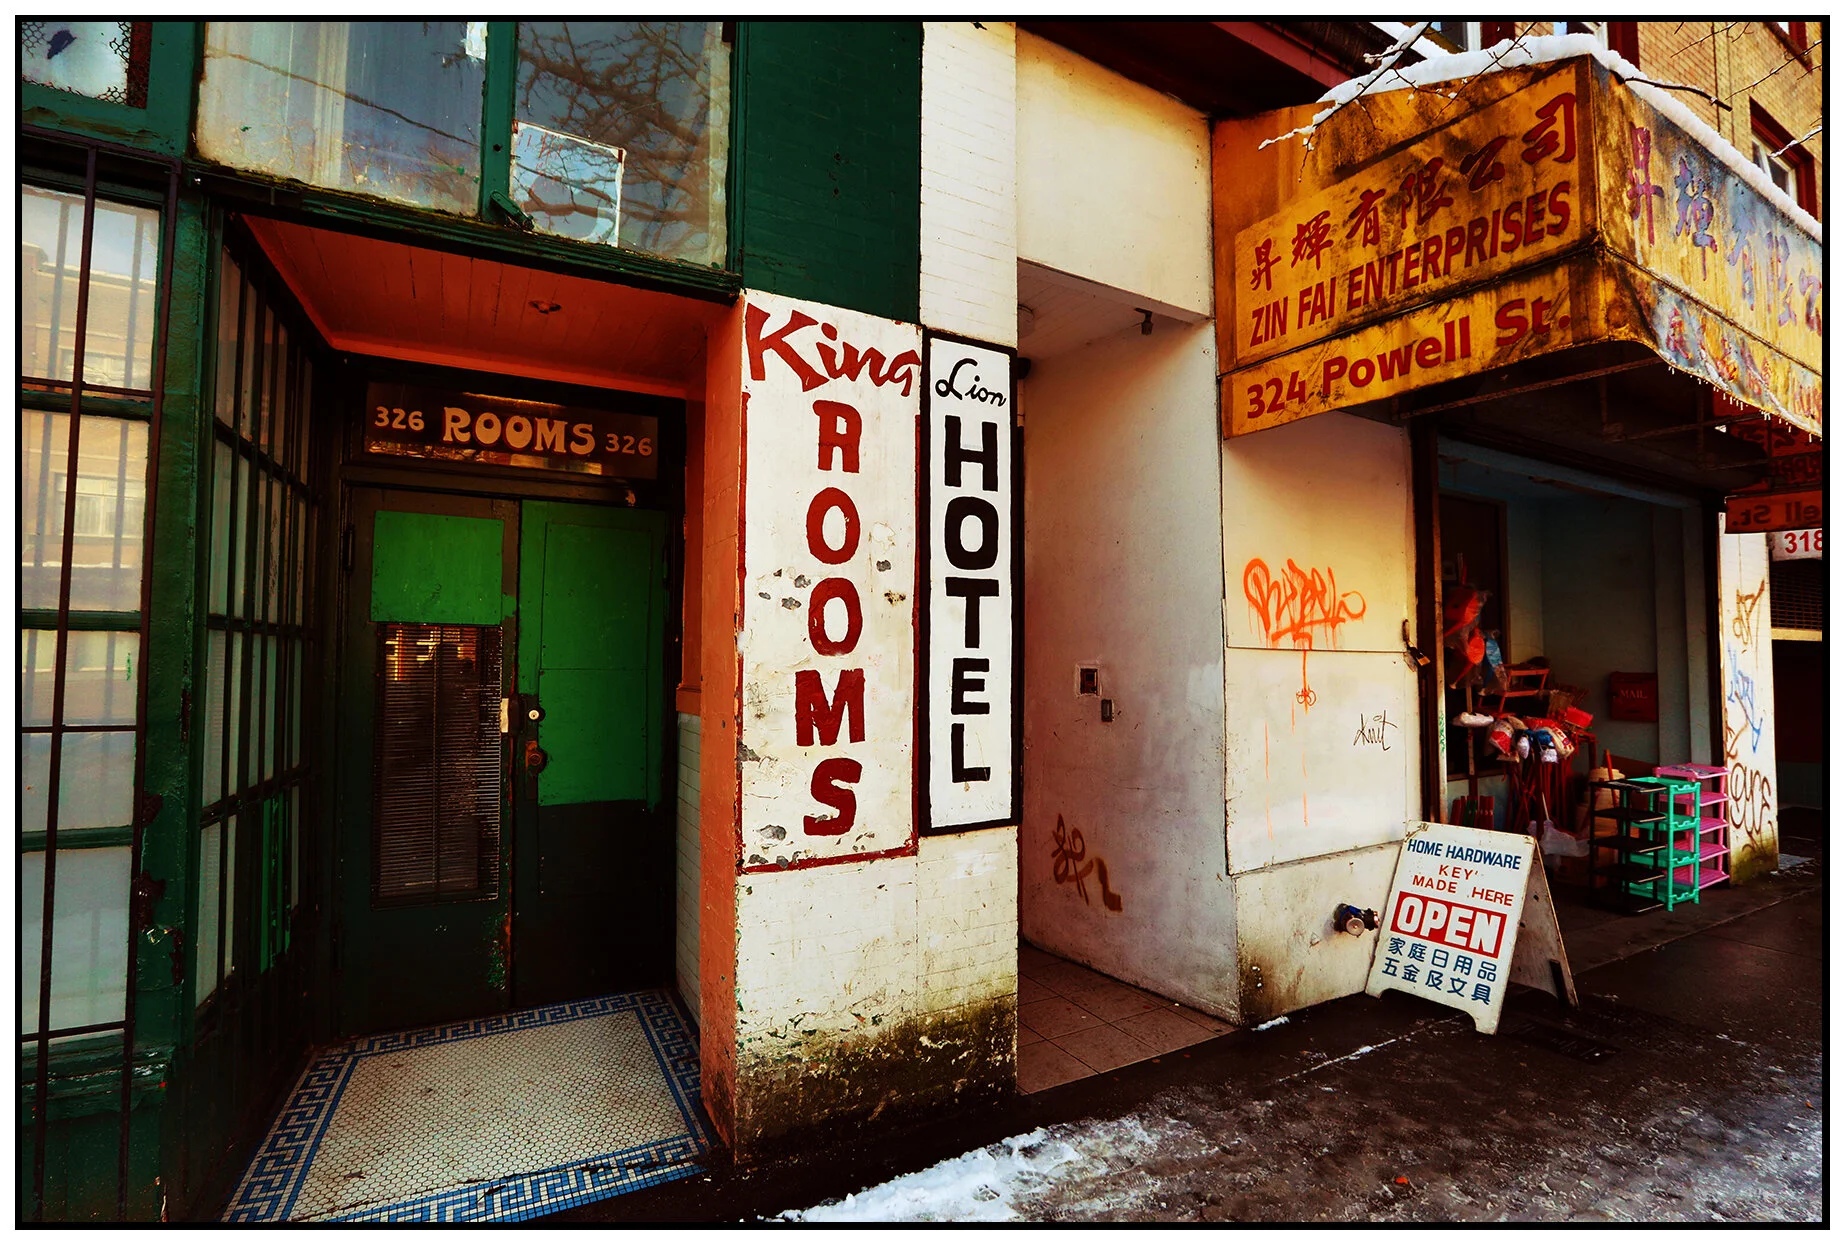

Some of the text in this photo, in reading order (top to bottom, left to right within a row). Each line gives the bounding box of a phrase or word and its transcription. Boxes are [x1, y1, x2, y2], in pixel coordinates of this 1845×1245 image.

[1250, 181, 1570, 347] ZIN FAI ENTERPRISES
[745, 302, 921, 397] King
[1247, 293, 1571, 419] 324 Powell St.
[934, 358, 1007, 407] Lion
[374, 406, 653, 456] 326 ROOMS 326
[795, 399, 867, 837] ROOMS
[944, 415, 1000, 784] HOTEL
[1619, 688, 1648, 700] MAIL
[1407, 838, 1522, 870] HOME HARDWARE
[1412, 875, 1458, 894] MADE
[1396, 896, 1501, 954] OPEN
[1381, 956, 1491, 1005] 五金及文具
[1387, 937, 1497, 983] 家庭日用品
